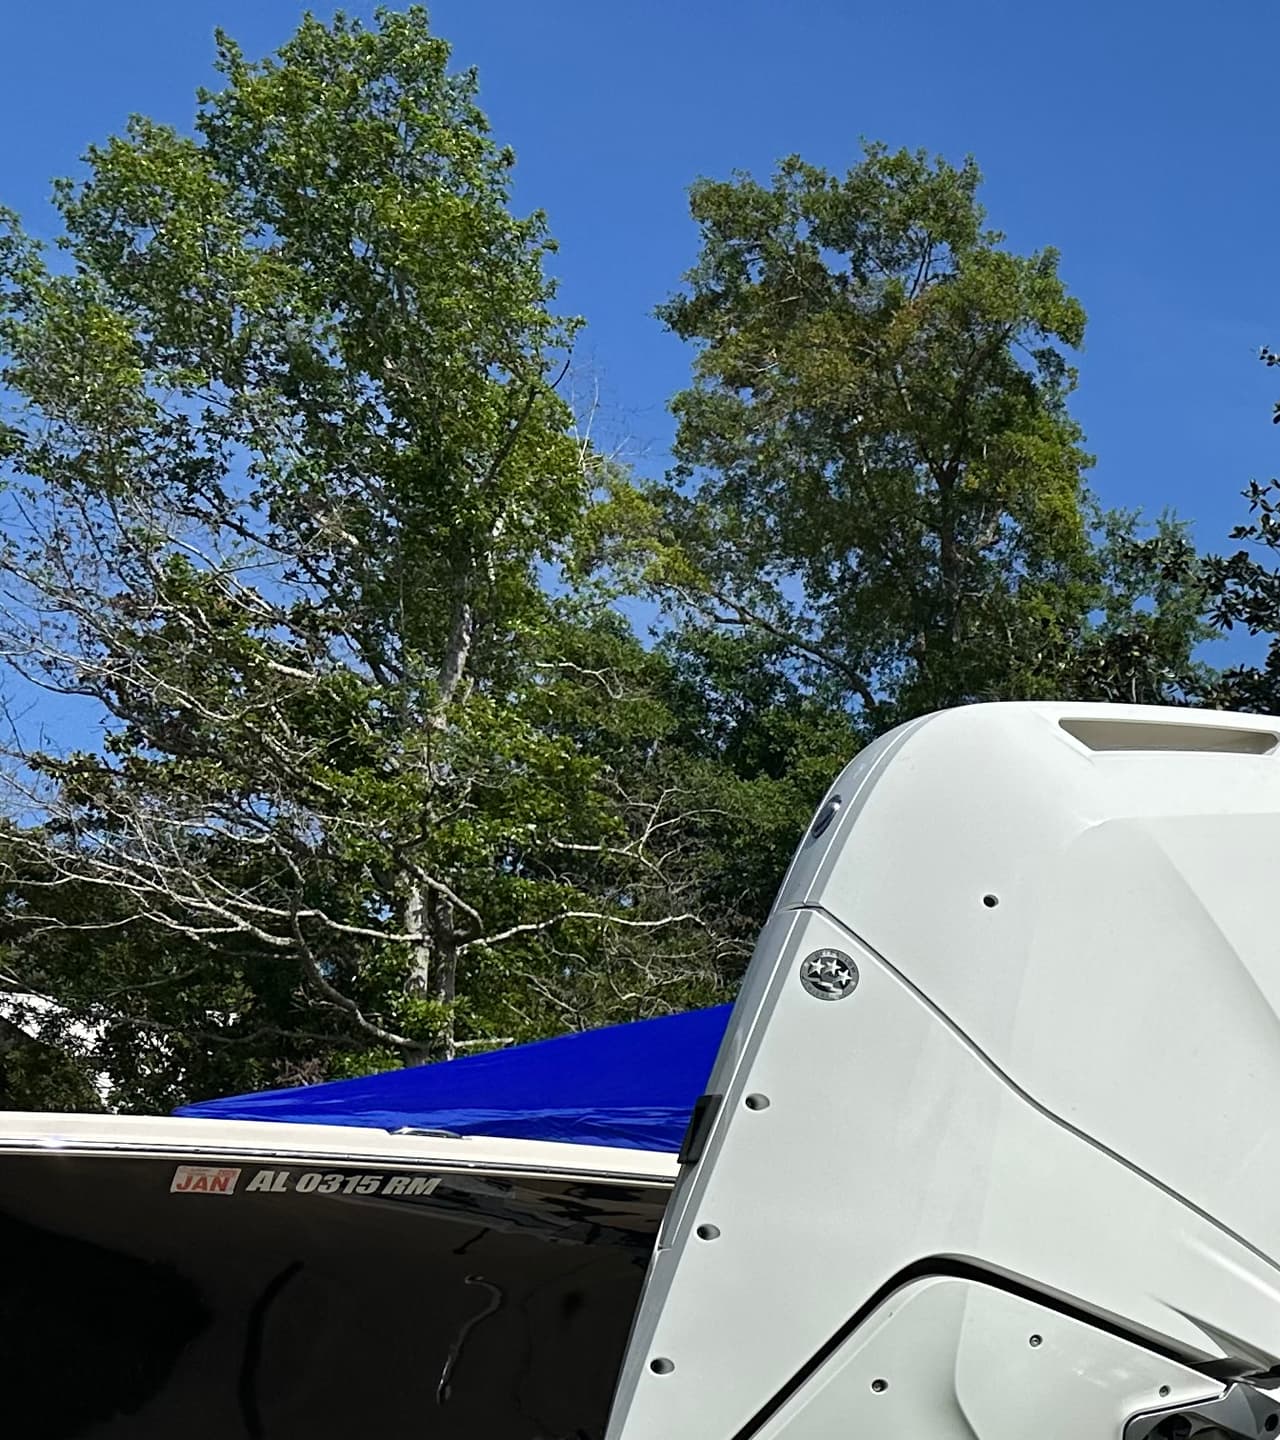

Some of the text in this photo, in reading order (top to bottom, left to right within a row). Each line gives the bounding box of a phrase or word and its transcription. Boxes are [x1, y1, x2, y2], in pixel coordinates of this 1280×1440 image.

[176, 1174, 231, 1192] JAN
[245, 1170, 443, 1196] AL 0315 RM
